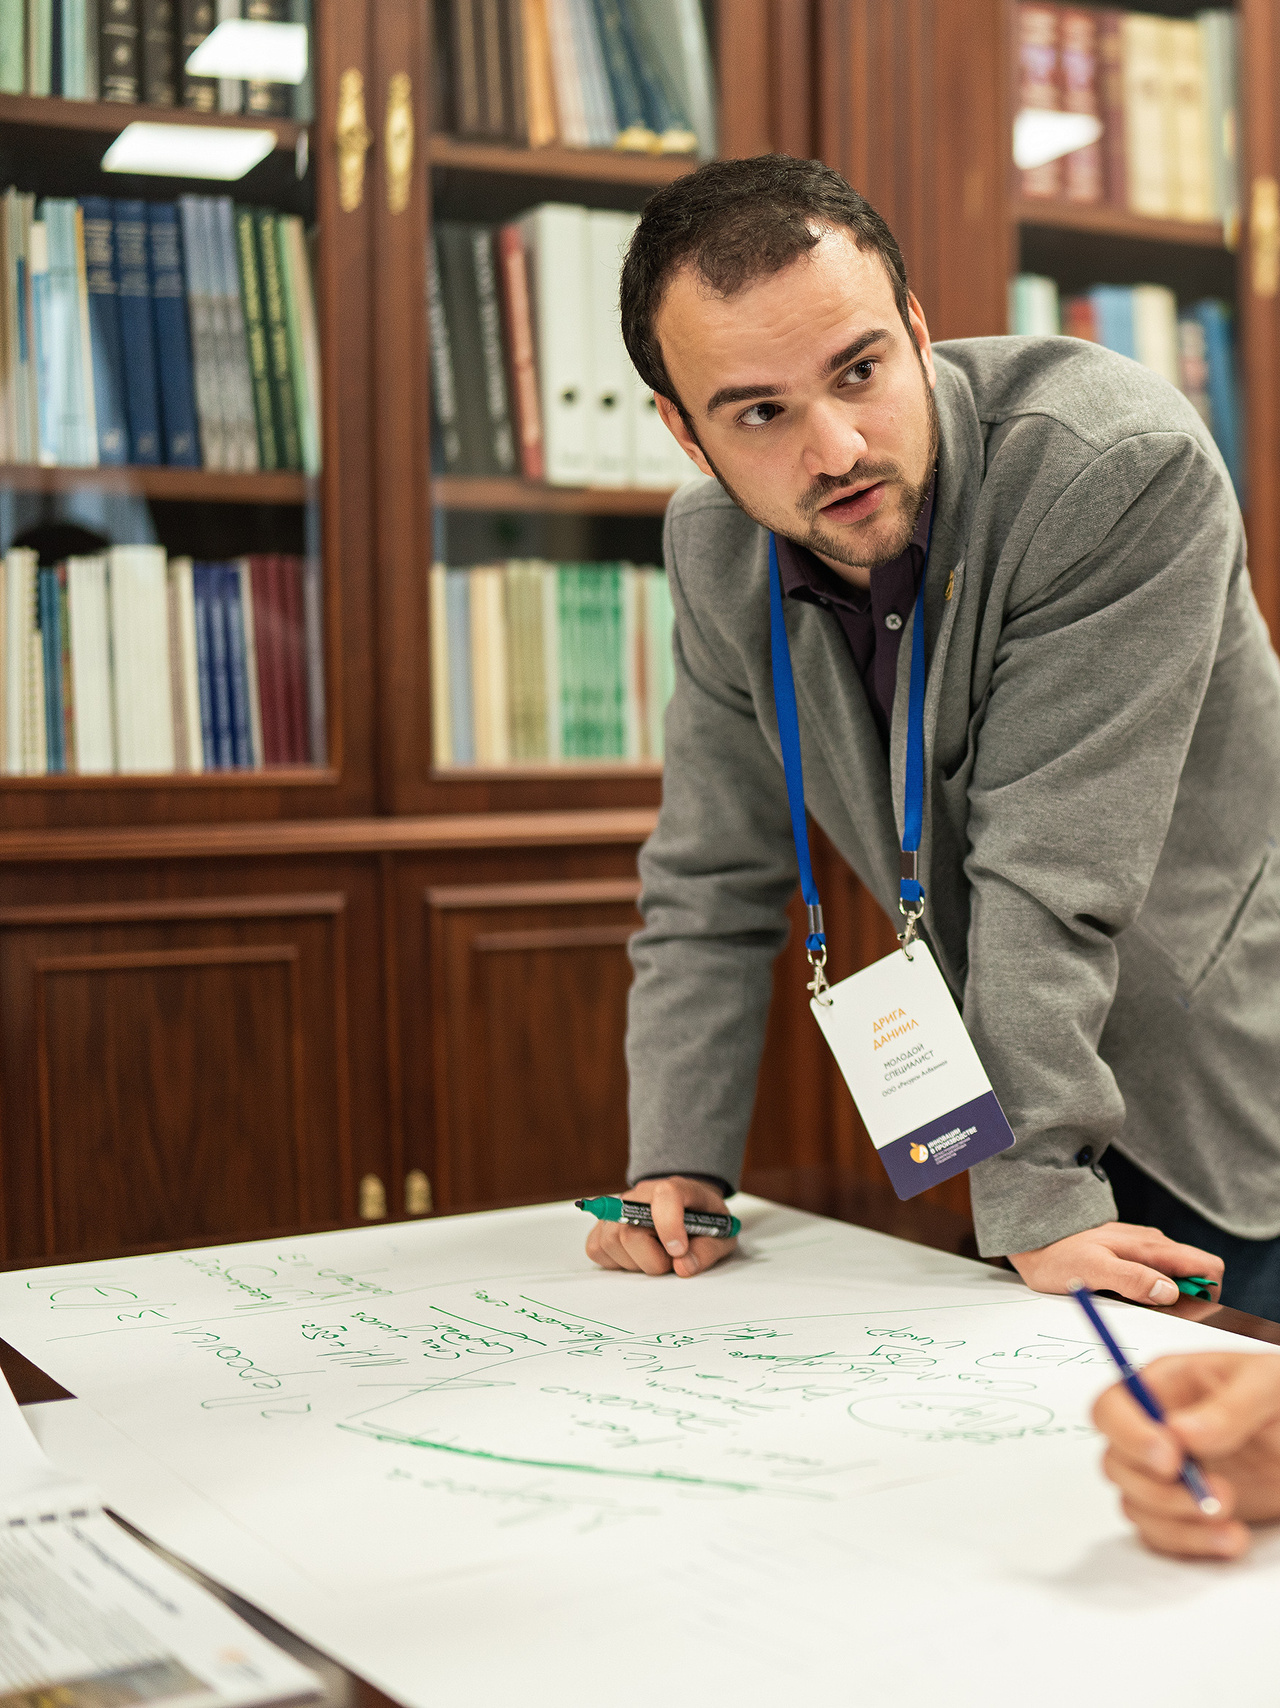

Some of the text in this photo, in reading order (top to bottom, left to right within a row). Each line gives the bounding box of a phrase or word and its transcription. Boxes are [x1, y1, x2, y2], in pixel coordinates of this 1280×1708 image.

[873, 1008, 906, 1033] ДРИГА
[873, 1019, 919, 1051] ДАНИИЛ
[884, 1043, 924, 1069] МОЛОДОЙ
[884, 1049, 934, 1081] СПЕЦИАЛИСТ
